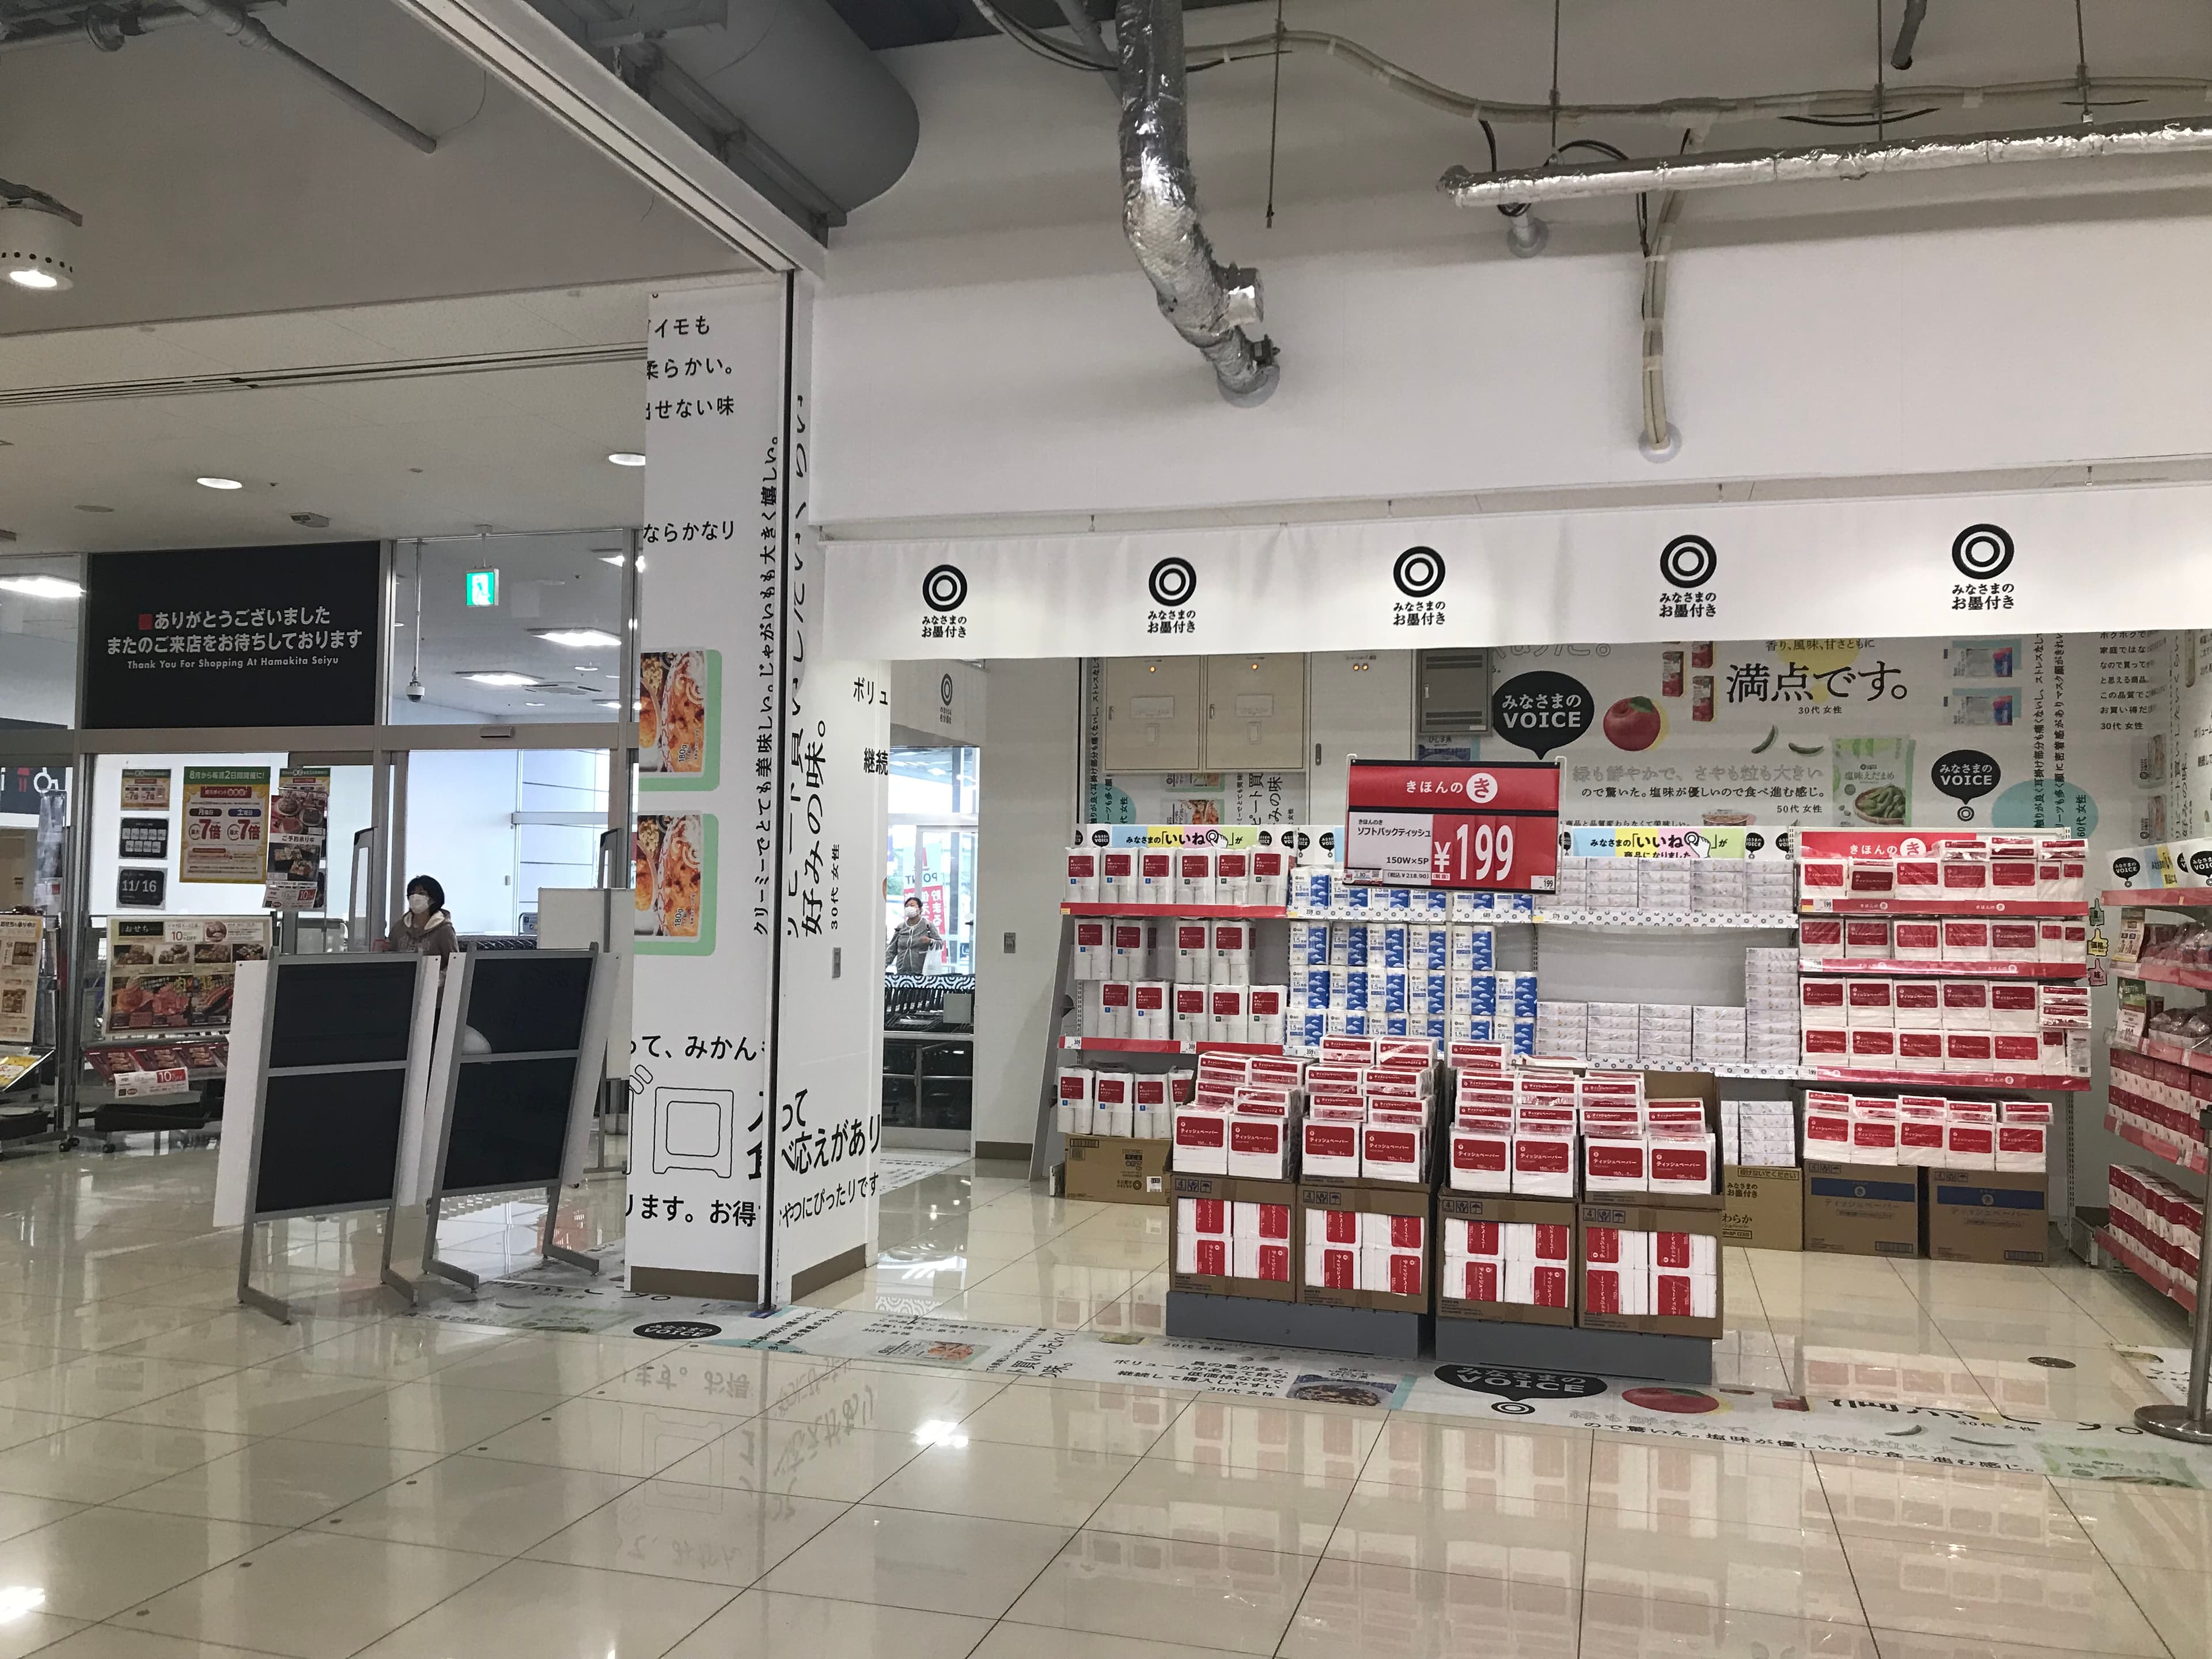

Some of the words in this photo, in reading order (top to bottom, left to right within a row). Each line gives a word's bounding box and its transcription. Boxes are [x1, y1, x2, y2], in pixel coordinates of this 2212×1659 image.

[647, 315, 710, 338] イモも
[1952, 582, 2015, 596] みなさまの
[1659, 591, 1717, 604] みなさまの
[1951, 596, 2016, 612] お墨付き
[1393, 601, 1446, 612] みなさまの
[1658, 604, 1718, 618] お墨付き
[154, 606, 330, 628] ありがとうございました
[922, 616, 967, 624] みなさまの
[1147, 609, 1196, 620] みなさまの
[1392, 612, 1446, 626] お墨付き
[921, 626, 967, 638] お墨付き
[1147, 620, 1196, 634] お墨付き
[108, 630, 362, 654] またのご来店をお待ちしております
[127, 660, 156, 669] Thank
[160, 660, 176, 668] You
[180, 659, 195, 668] For
[199, 658, 243, 669] Shopping
[247, 658, 257, 666] At
[261, 656, 308, 666] Hamakita
[312, 656, 338, 666] Seiyu
[1726, 661, 1908, 703] 満点です。
[1502, 694, 1582, 710] みなさまの
[1798, 706, 1819, 715] 30代
[1823, 705, 1843, 715] 女性
[1503, 711, 1581, 729] VOICE
[2101, 722, 2120, 730] 30代
[2124, 721, 2143, 730] 女性
[1939, 763, 1993, 774] みなさまの
[1940, 774, 1993, 786] VOICE
[1581, 785, 1825, 799] ので驚いた。塩味が優しいので食べ進む感じ。
[1777, 804, 1800, 814] 50代
[1803, 804, 1823, 813] 女性
[2076, 794, 2086, 812] 女性
[802, 720, 827, 937] 好みの味。
[831, 844, 840, 880] 女性
[1544, 880, 1553, 888] 199
[831, 887, 840, 930] 30代
[1727, 1190, 1758, 1198] お墨付き
[1457, 1374, 1585, 1393] VOICE
